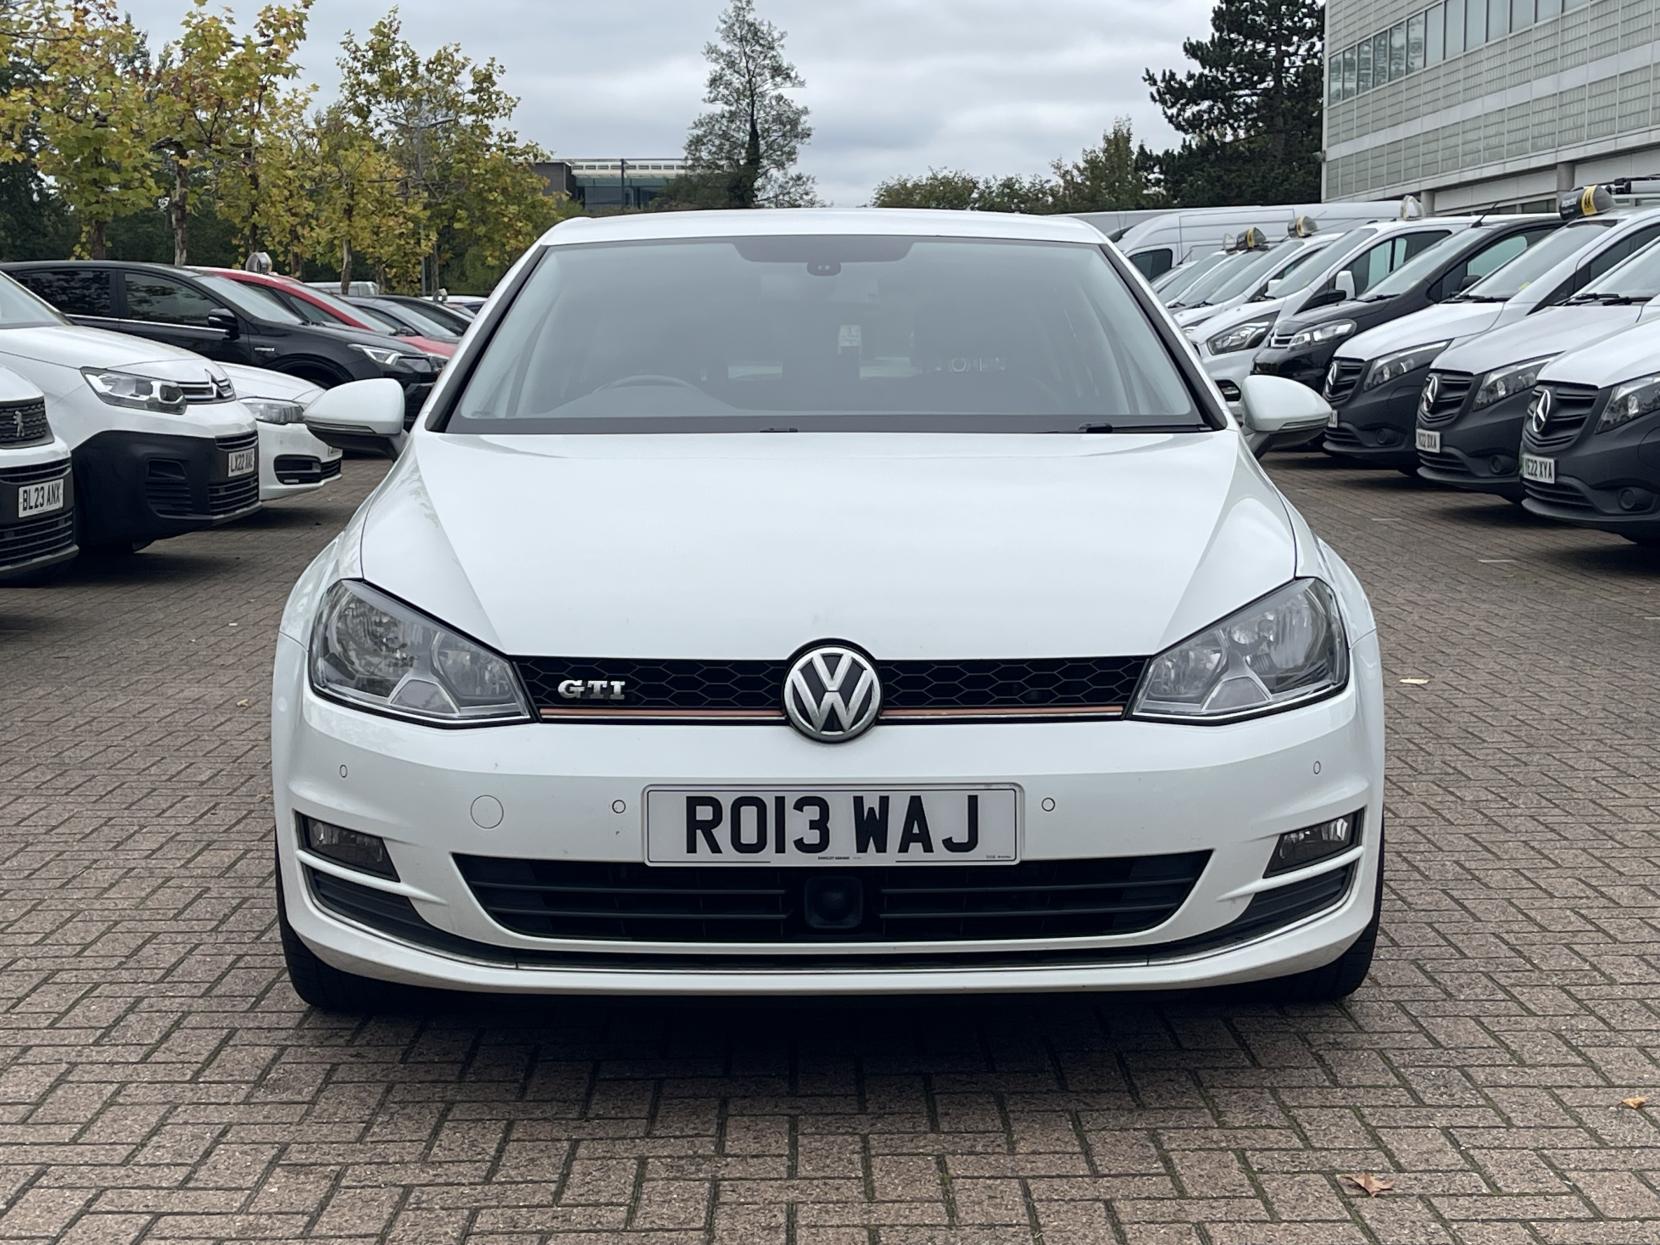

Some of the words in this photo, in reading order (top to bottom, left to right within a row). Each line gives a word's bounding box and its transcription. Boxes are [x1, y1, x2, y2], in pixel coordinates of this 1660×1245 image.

[1539, 460, 1553, 480] XYA
[23, 485, 45, 511] BL23
[557, 679, 626, 700] GTI
[686, 795, 830, 854] RO13
[852, 794, 979, 854] WAJ
